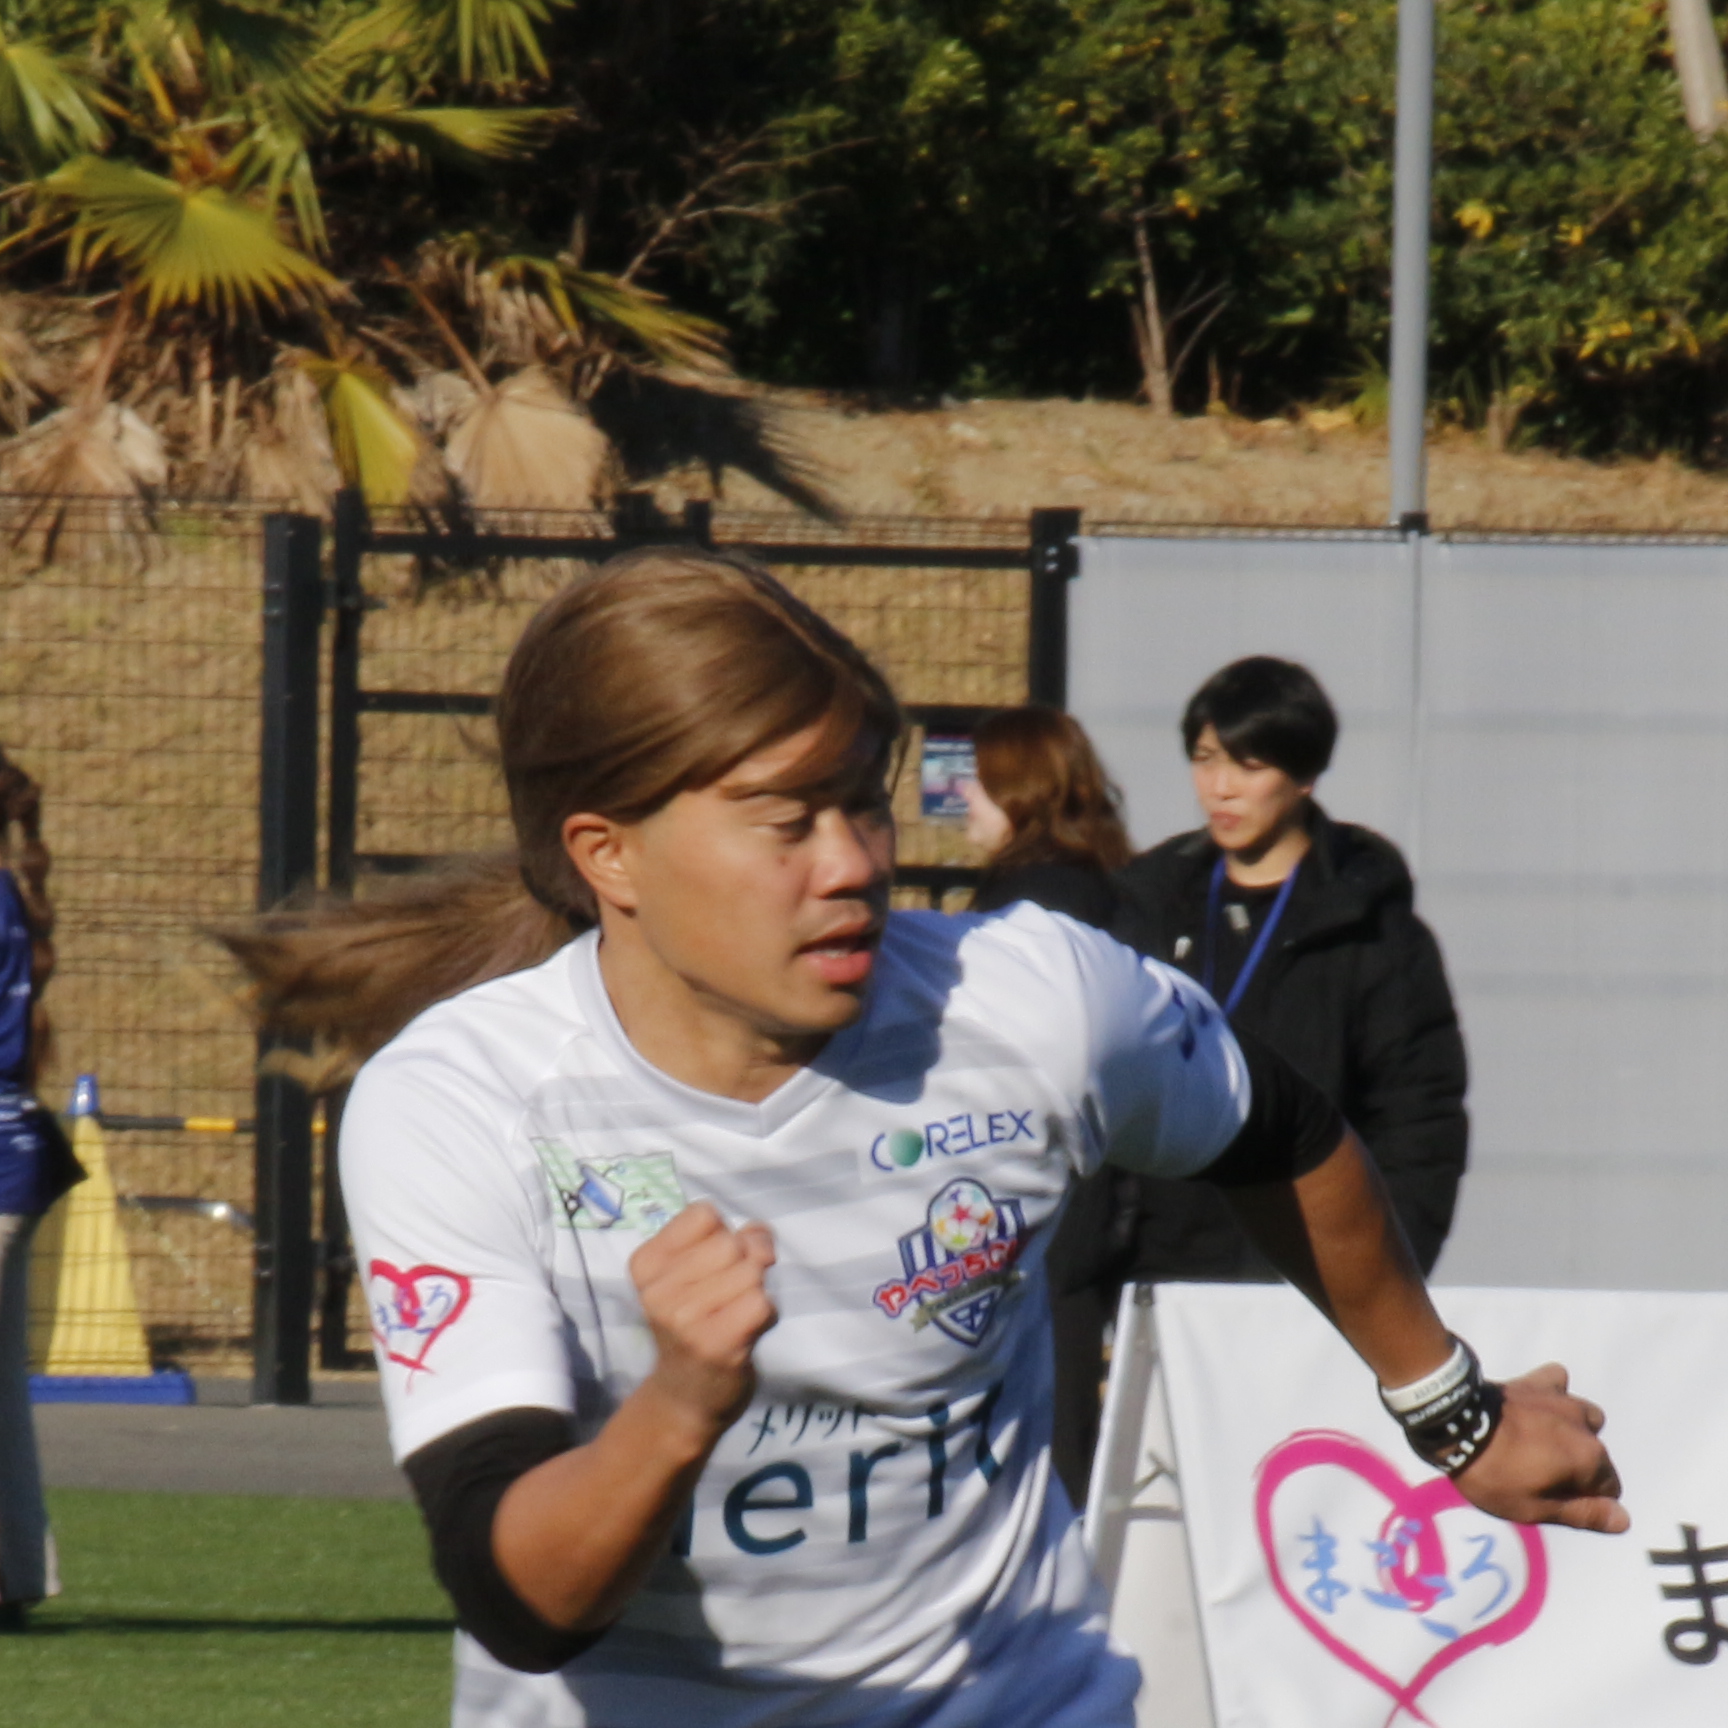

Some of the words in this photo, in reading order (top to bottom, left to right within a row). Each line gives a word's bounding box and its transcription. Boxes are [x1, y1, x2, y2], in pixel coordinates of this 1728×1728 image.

[672, 1379, 1005, 1556] erit
[1296, 1514, 1512, 1642] まごころ
